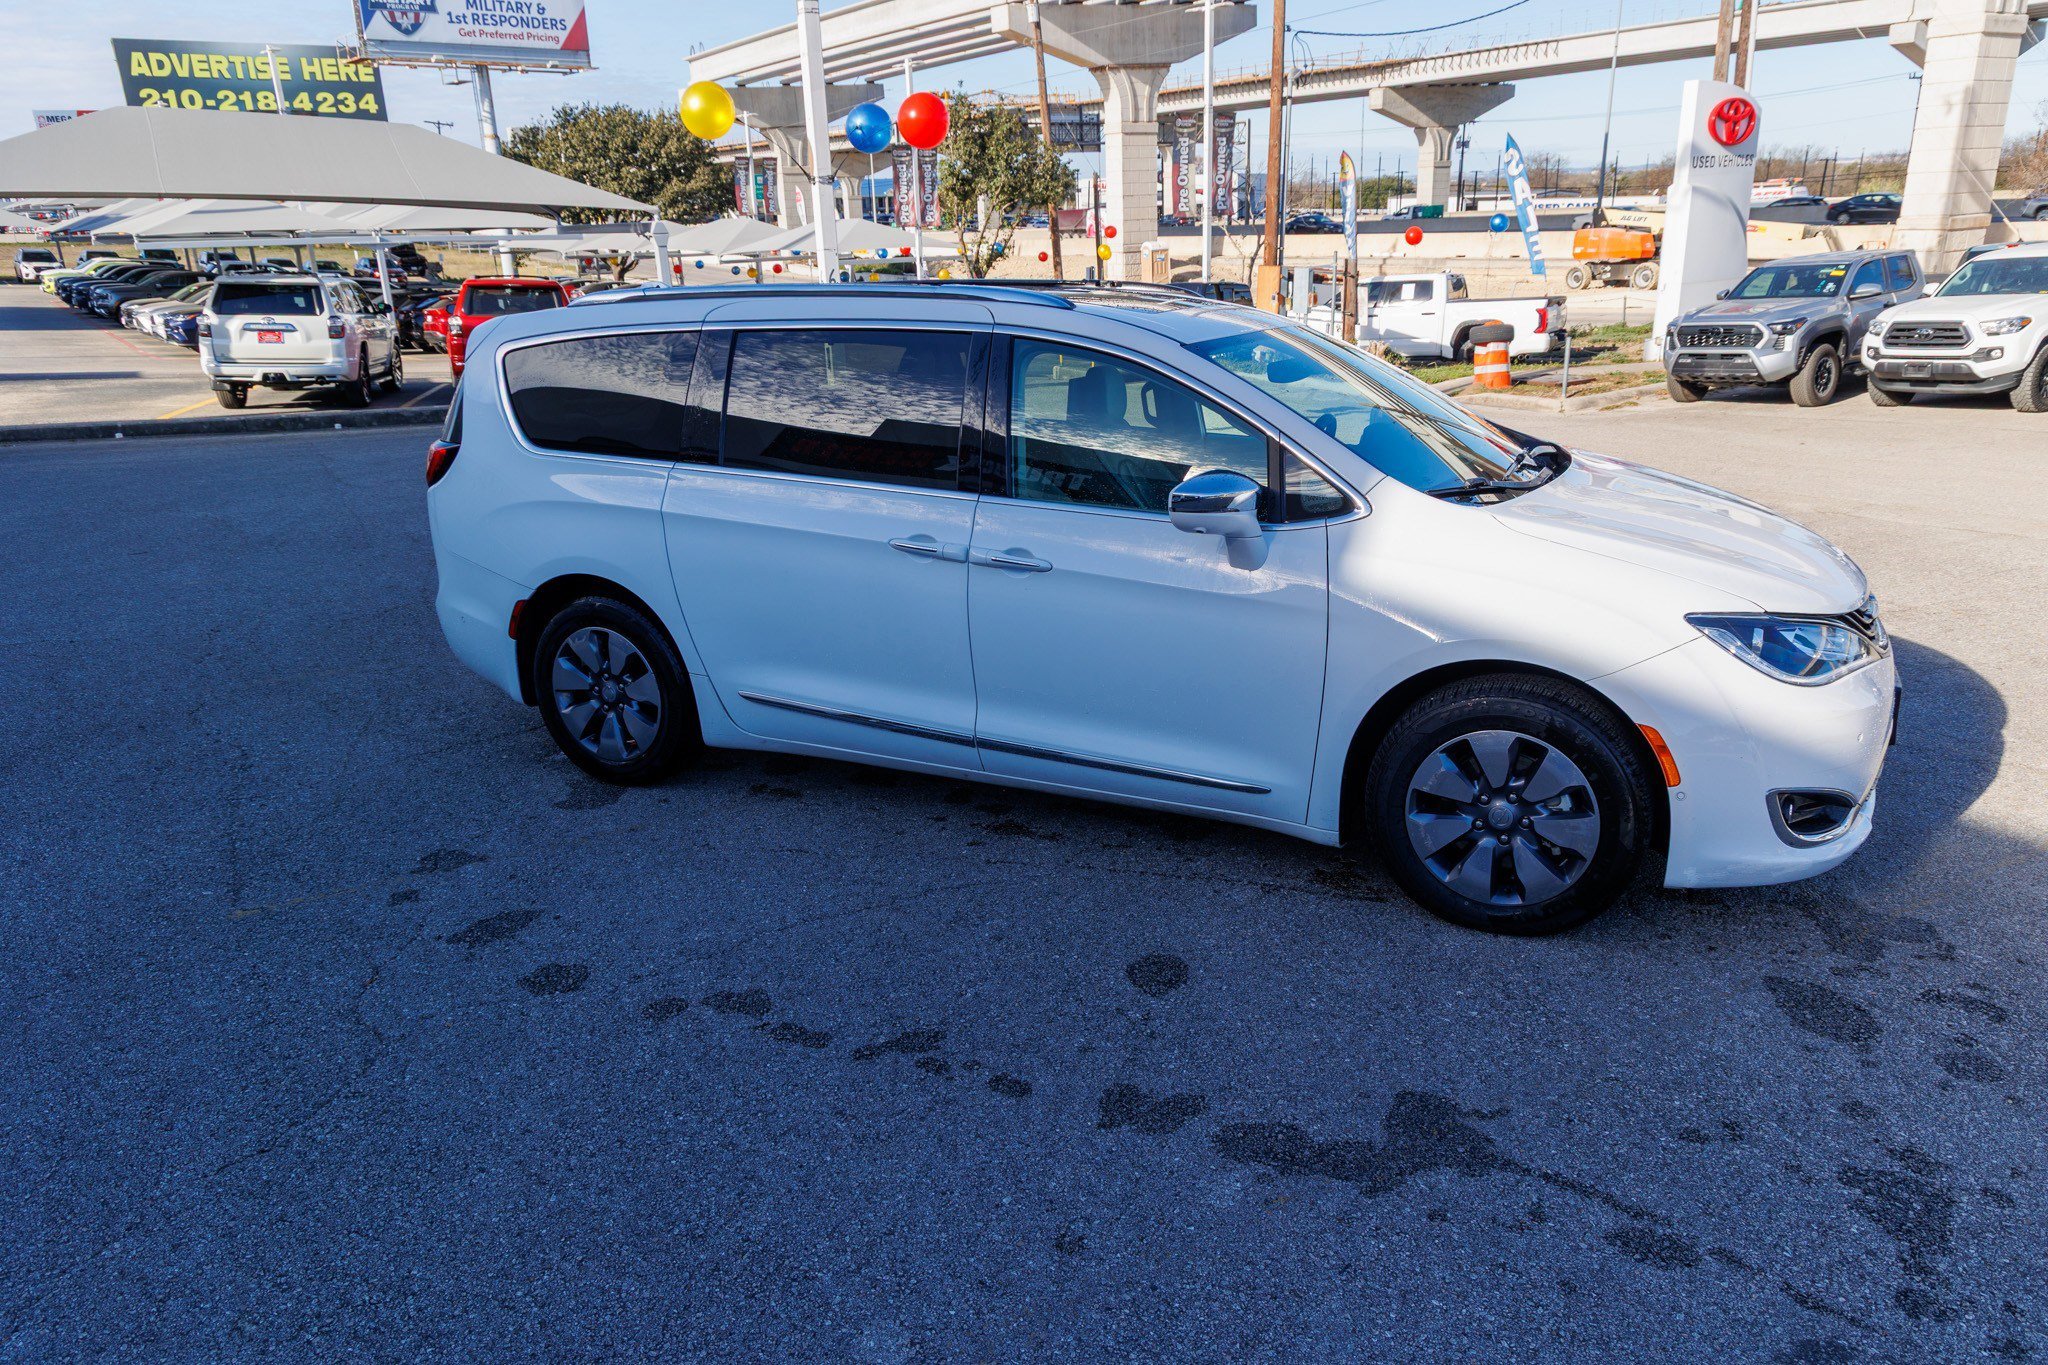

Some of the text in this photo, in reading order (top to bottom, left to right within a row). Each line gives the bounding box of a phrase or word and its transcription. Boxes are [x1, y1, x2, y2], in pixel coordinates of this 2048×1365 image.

[466, 0, 546, 15] MILITARY &
[446, 11, 567, 31] 1st RESPONDERS
[458, 27, 560, 44] Get Preferred Pricing
[130, 51, 376, 83] ADVERTISE HERE
[138, 88, 379, 114] 210-218-4234
[1177, 137, 1190, 186] Owned
[1215, 136, 1227, 185] Owned
[1692, 153, 1755, 169] USED VEHICLES
[897, 164, 908, 203] Owned
[1178, 188, 1190, 212] Pre
